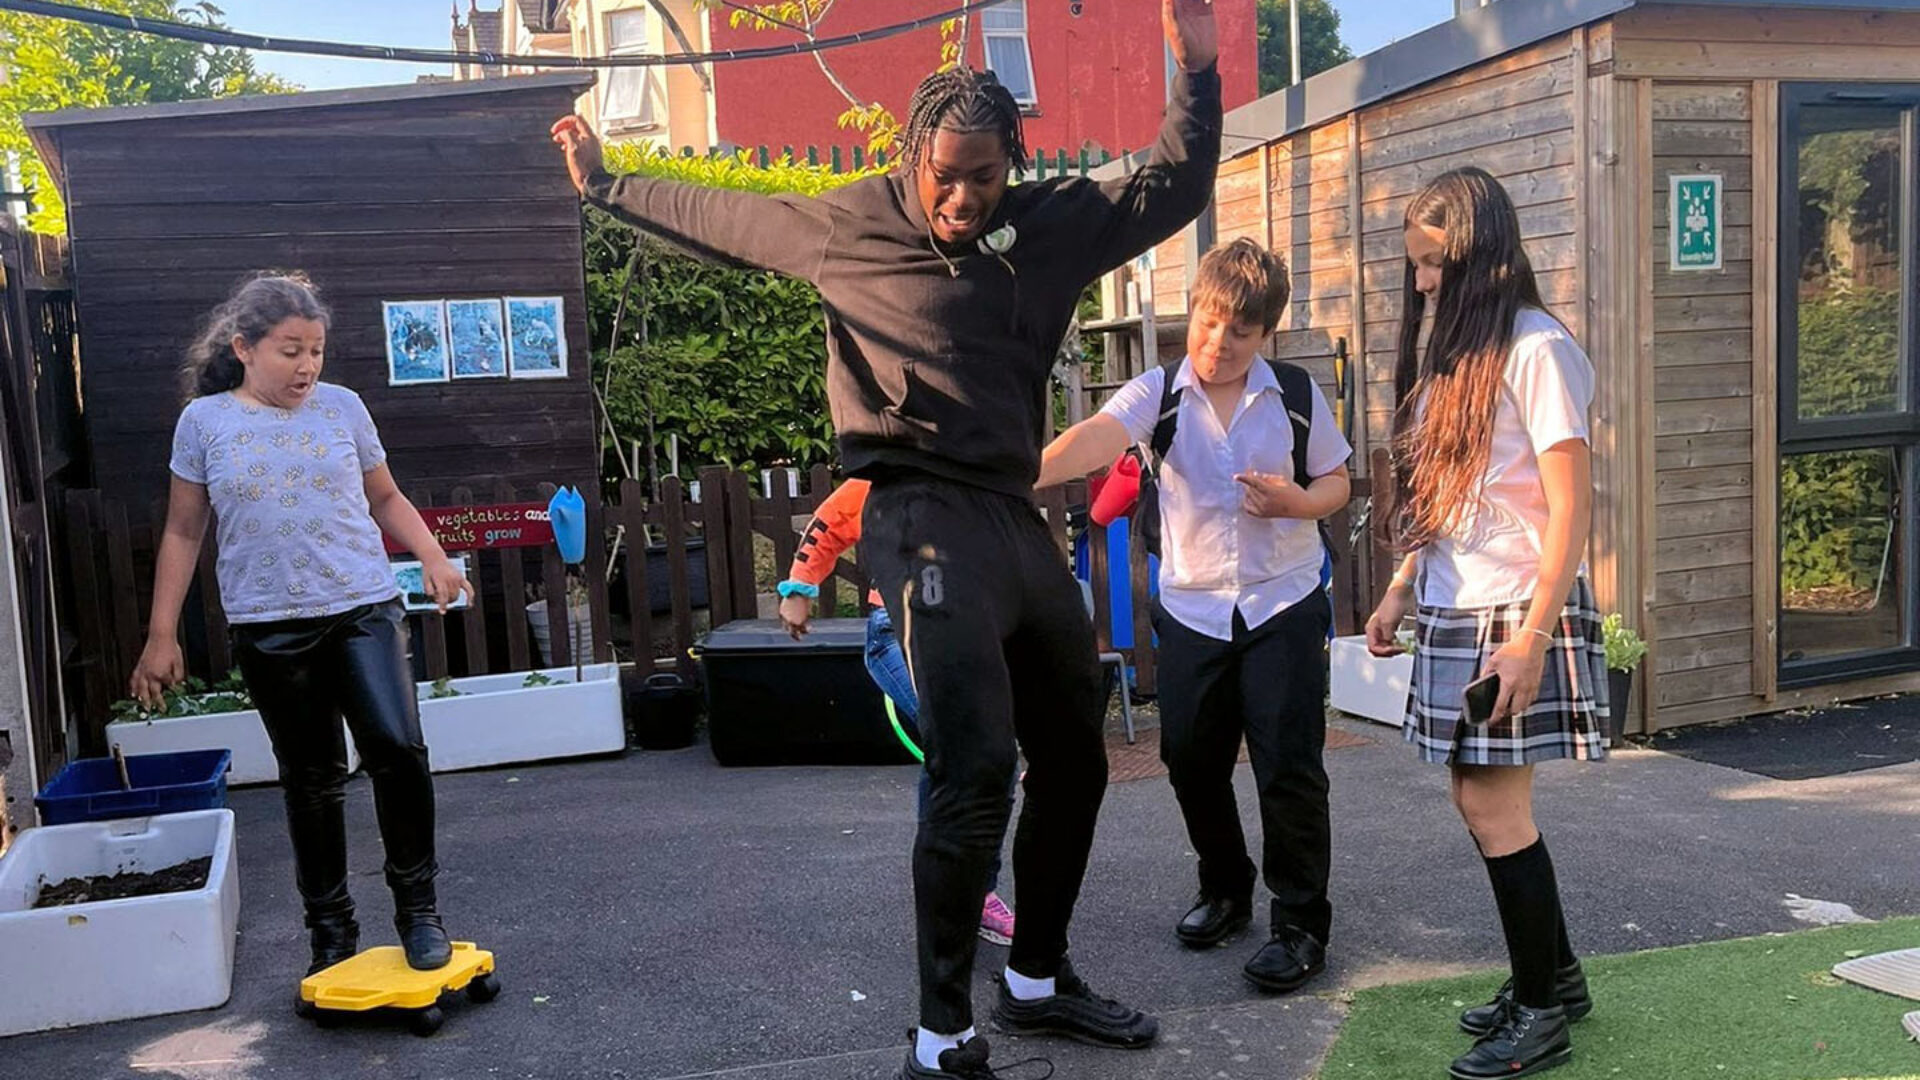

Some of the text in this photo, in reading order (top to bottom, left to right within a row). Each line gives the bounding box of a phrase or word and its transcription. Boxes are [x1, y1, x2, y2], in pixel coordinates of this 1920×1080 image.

[437, 508, 519, 530] vegetables
[434, 528, 521, 545] fruits grow
[921, 565, 943, 605] 8
